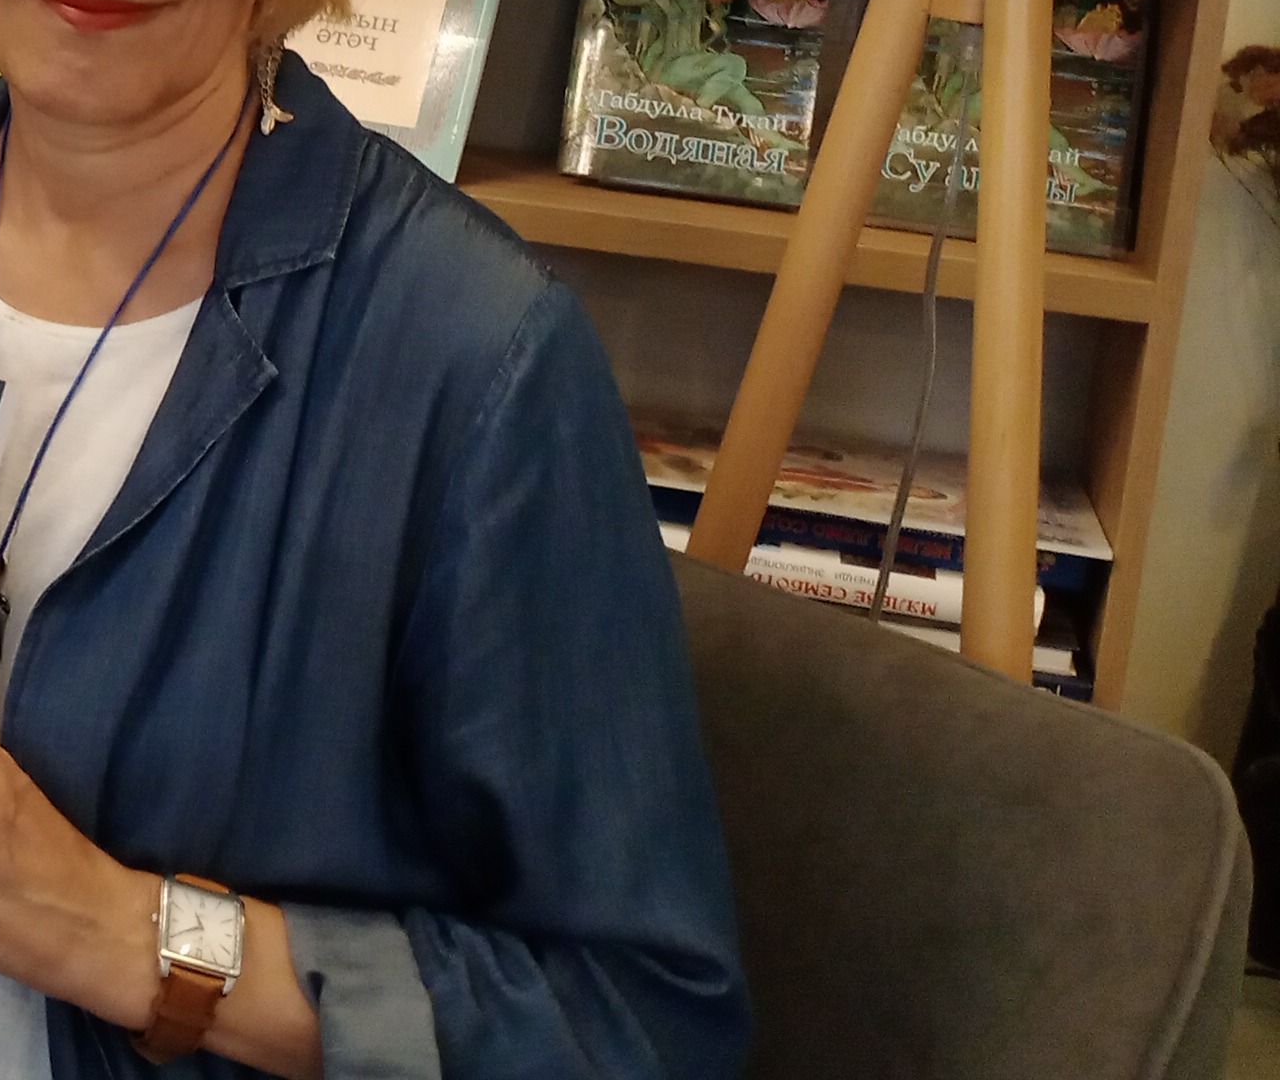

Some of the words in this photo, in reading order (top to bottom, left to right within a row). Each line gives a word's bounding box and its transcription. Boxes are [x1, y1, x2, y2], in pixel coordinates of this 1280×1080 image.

[316, 29, 377, 51] ӘТӘЧ
[597, 89, 703, 121] Габдулла
[711, 104, 787, 132] Тукай
[595, 116, 786, 175] Водяная
